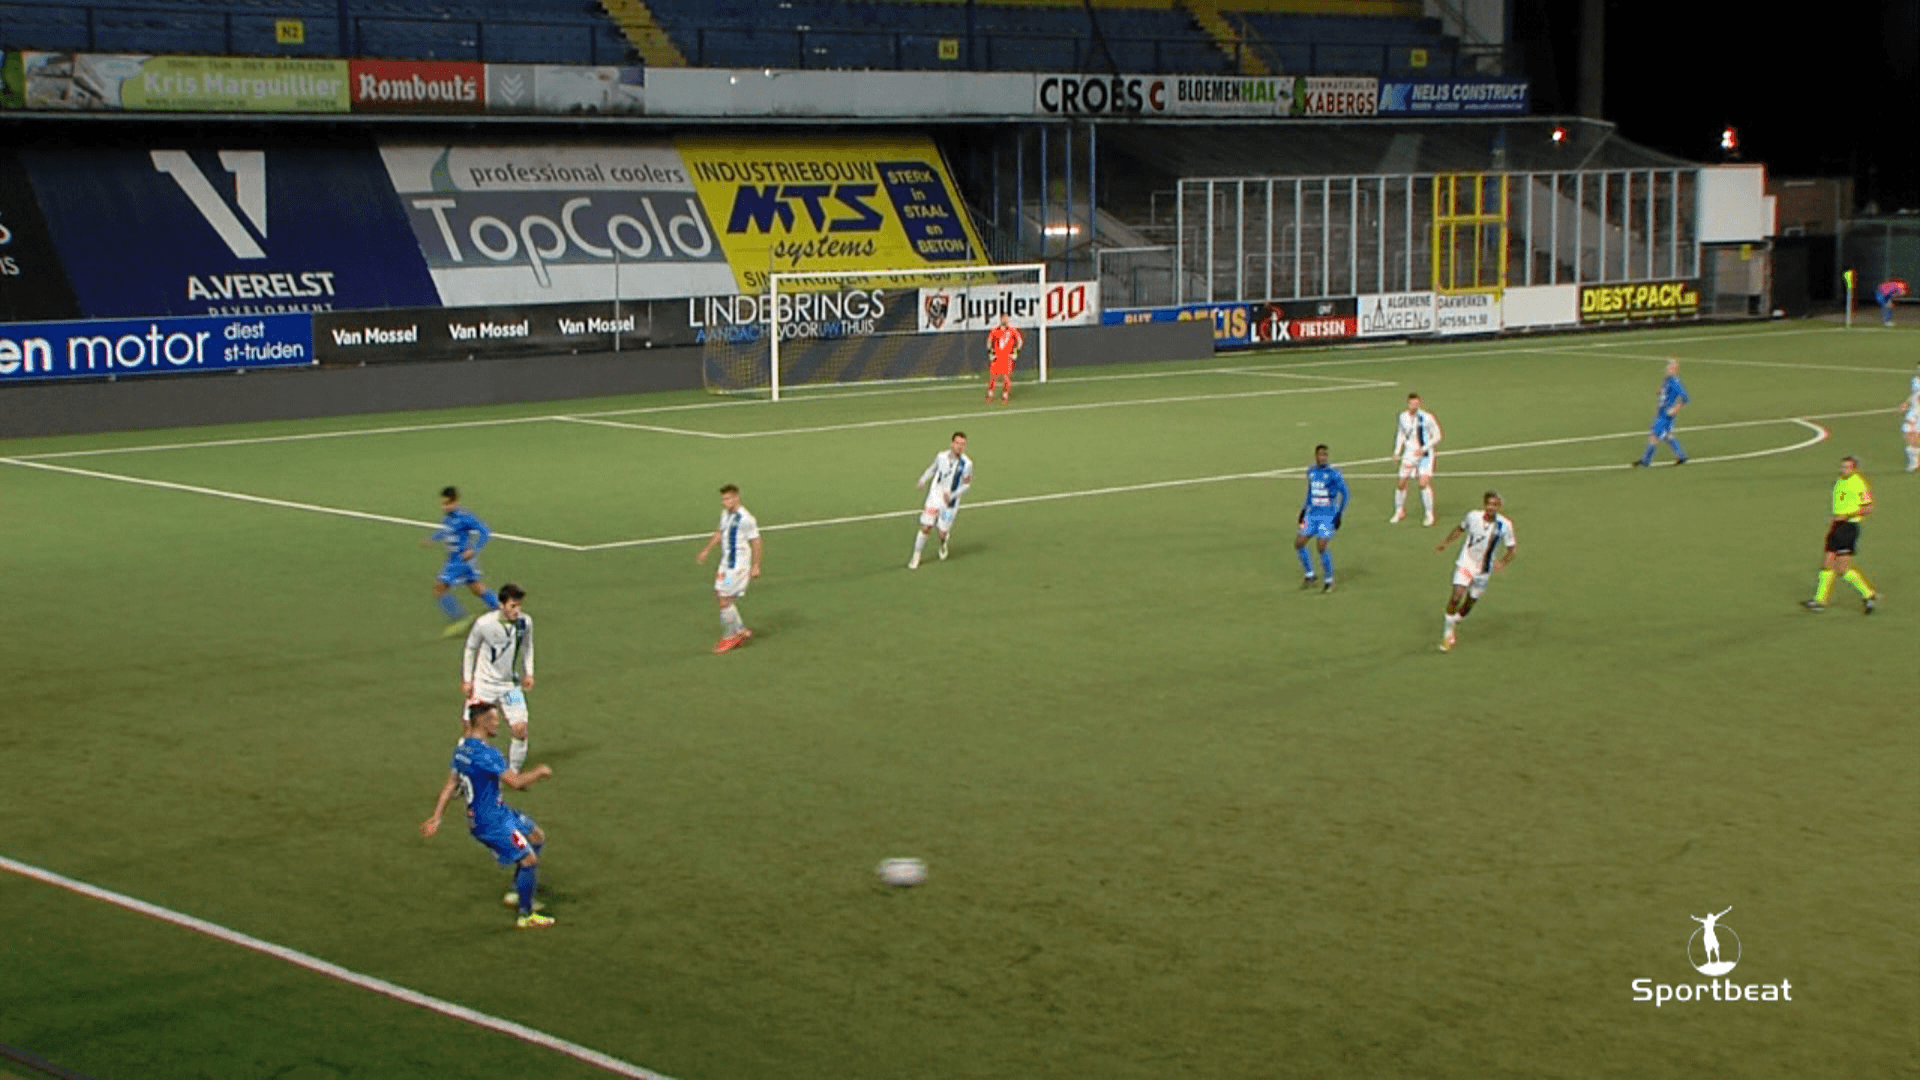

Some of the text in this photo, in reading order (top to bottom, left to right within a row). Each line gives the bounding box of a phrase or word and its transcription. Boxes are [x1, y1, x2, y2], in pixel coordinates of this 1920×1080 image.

[144, 71, 341, 98] Kris Marguillier
[359, 73, 478, 100] Rombouts
[1040, 77, 1143, 113] CROES
[1411, 85, 1449, 100] NELIS
[1452, 84, 1528, 100] CONSTRUCT
[1304, 91, 1375, 113] KABERGS
[469, 162, 684, 186] professional coolers
[694, 162, 875, 183] INDUSTRIEBOUW
[887, 170, 934, 185] STERK
[911, 188, 926, 200] in
[726, 184, 884, 234] MTS
[904, 204, 948, 218] STAAL
[926, 224, 943, 235] en
[412, 197, 712, 288] TopCold
[774, 236, 876, 266] systems
[917, 239, 965, 252] BETON
[188, 272, 335, 300] A.VERELST
[689, 289, 885, 327] LINDEBRINGS
[953, 292, 1040, 325] Jupiler
[1388, 295, 1431, 308] ALGEMENE
[224, 321, 265, 340] diest
[331, 325, 418, 346] Van Mossel
[449, 319, 529, 340] Van Mossel
[557, 315, 635, 335] Van Mossel
[1300, 319, 1346, 337] FIETSEN
[67, 323, 211, 371] motor
[224, 341, 304, 362] st-truiden
